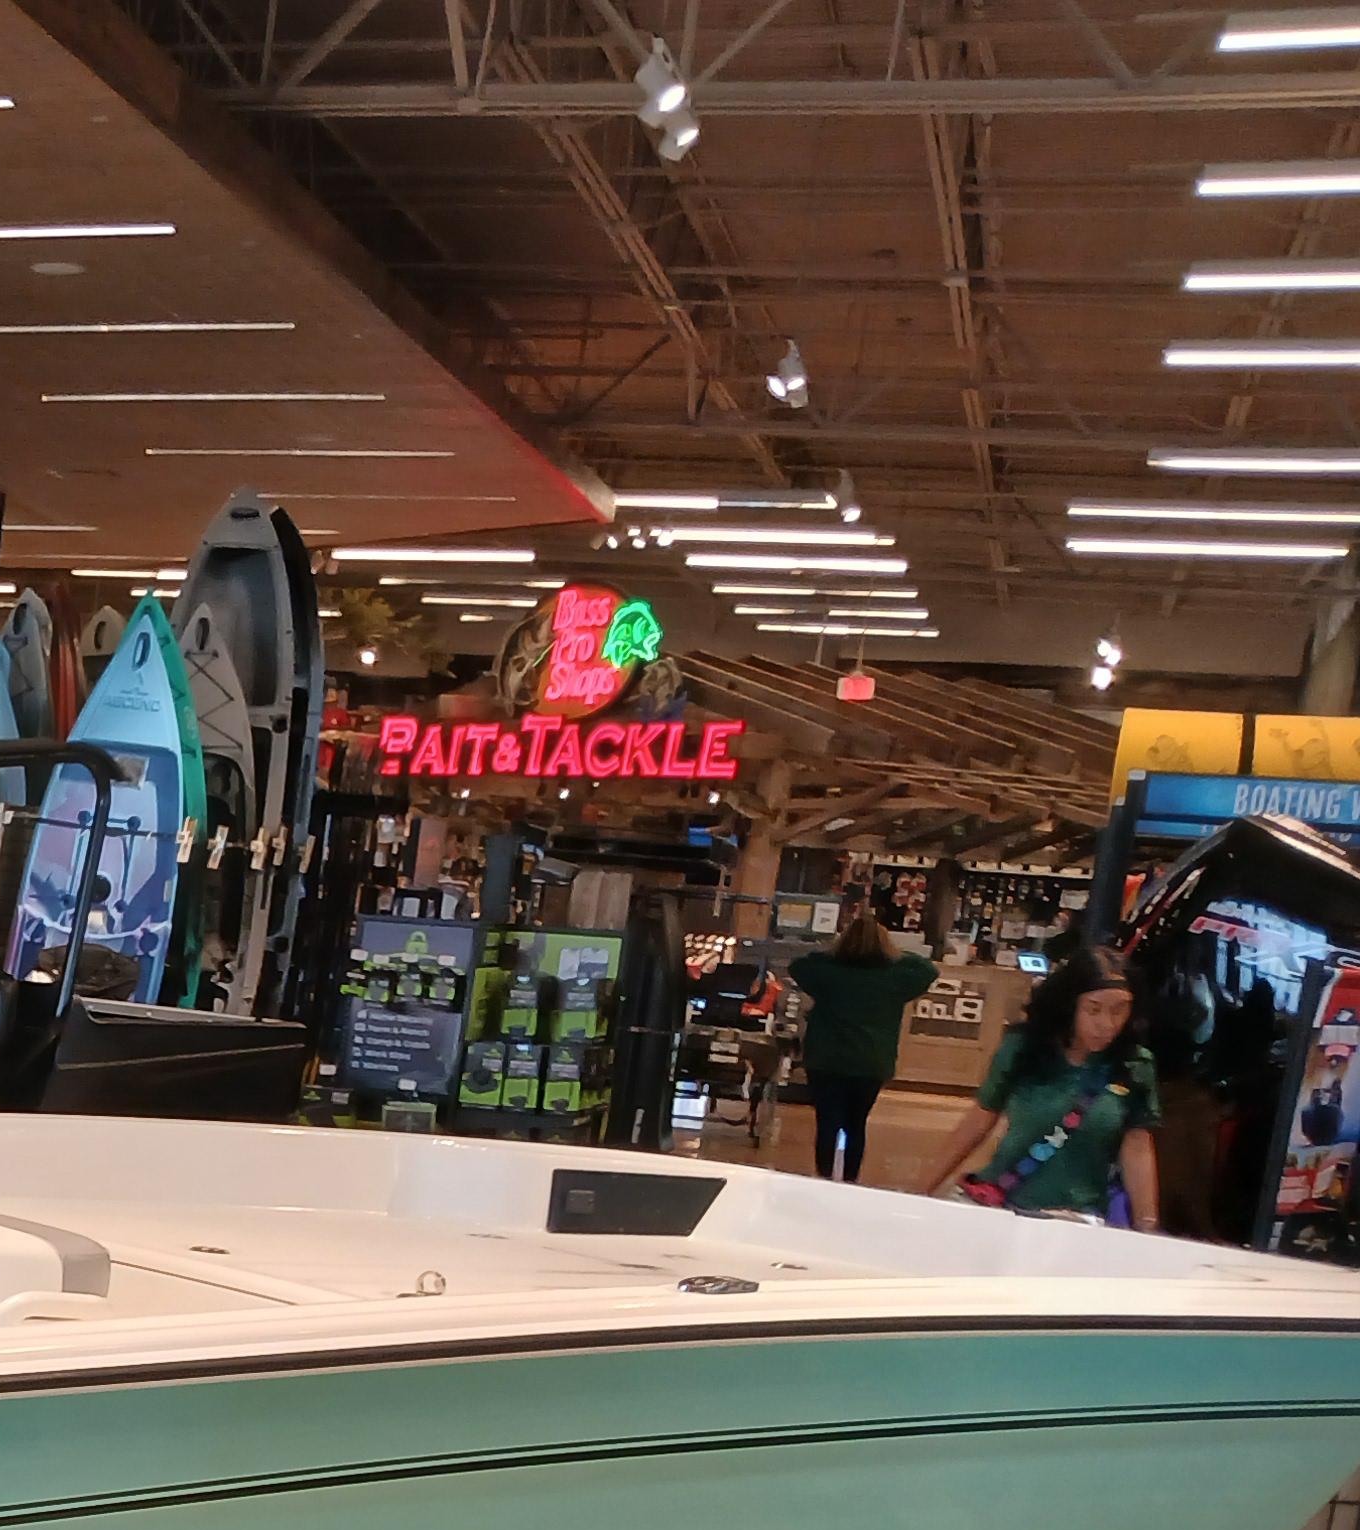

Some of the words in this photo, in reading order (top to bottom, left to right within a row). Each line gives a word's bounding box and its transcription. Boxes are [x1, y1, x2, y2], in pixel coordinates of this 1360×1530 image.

[552, 589, 611, 630] Bass
[551, 631, 594, 664] Pro
[545, 663, 619, 704] Shops
[1234, 783, 1341, 820] BOATING
